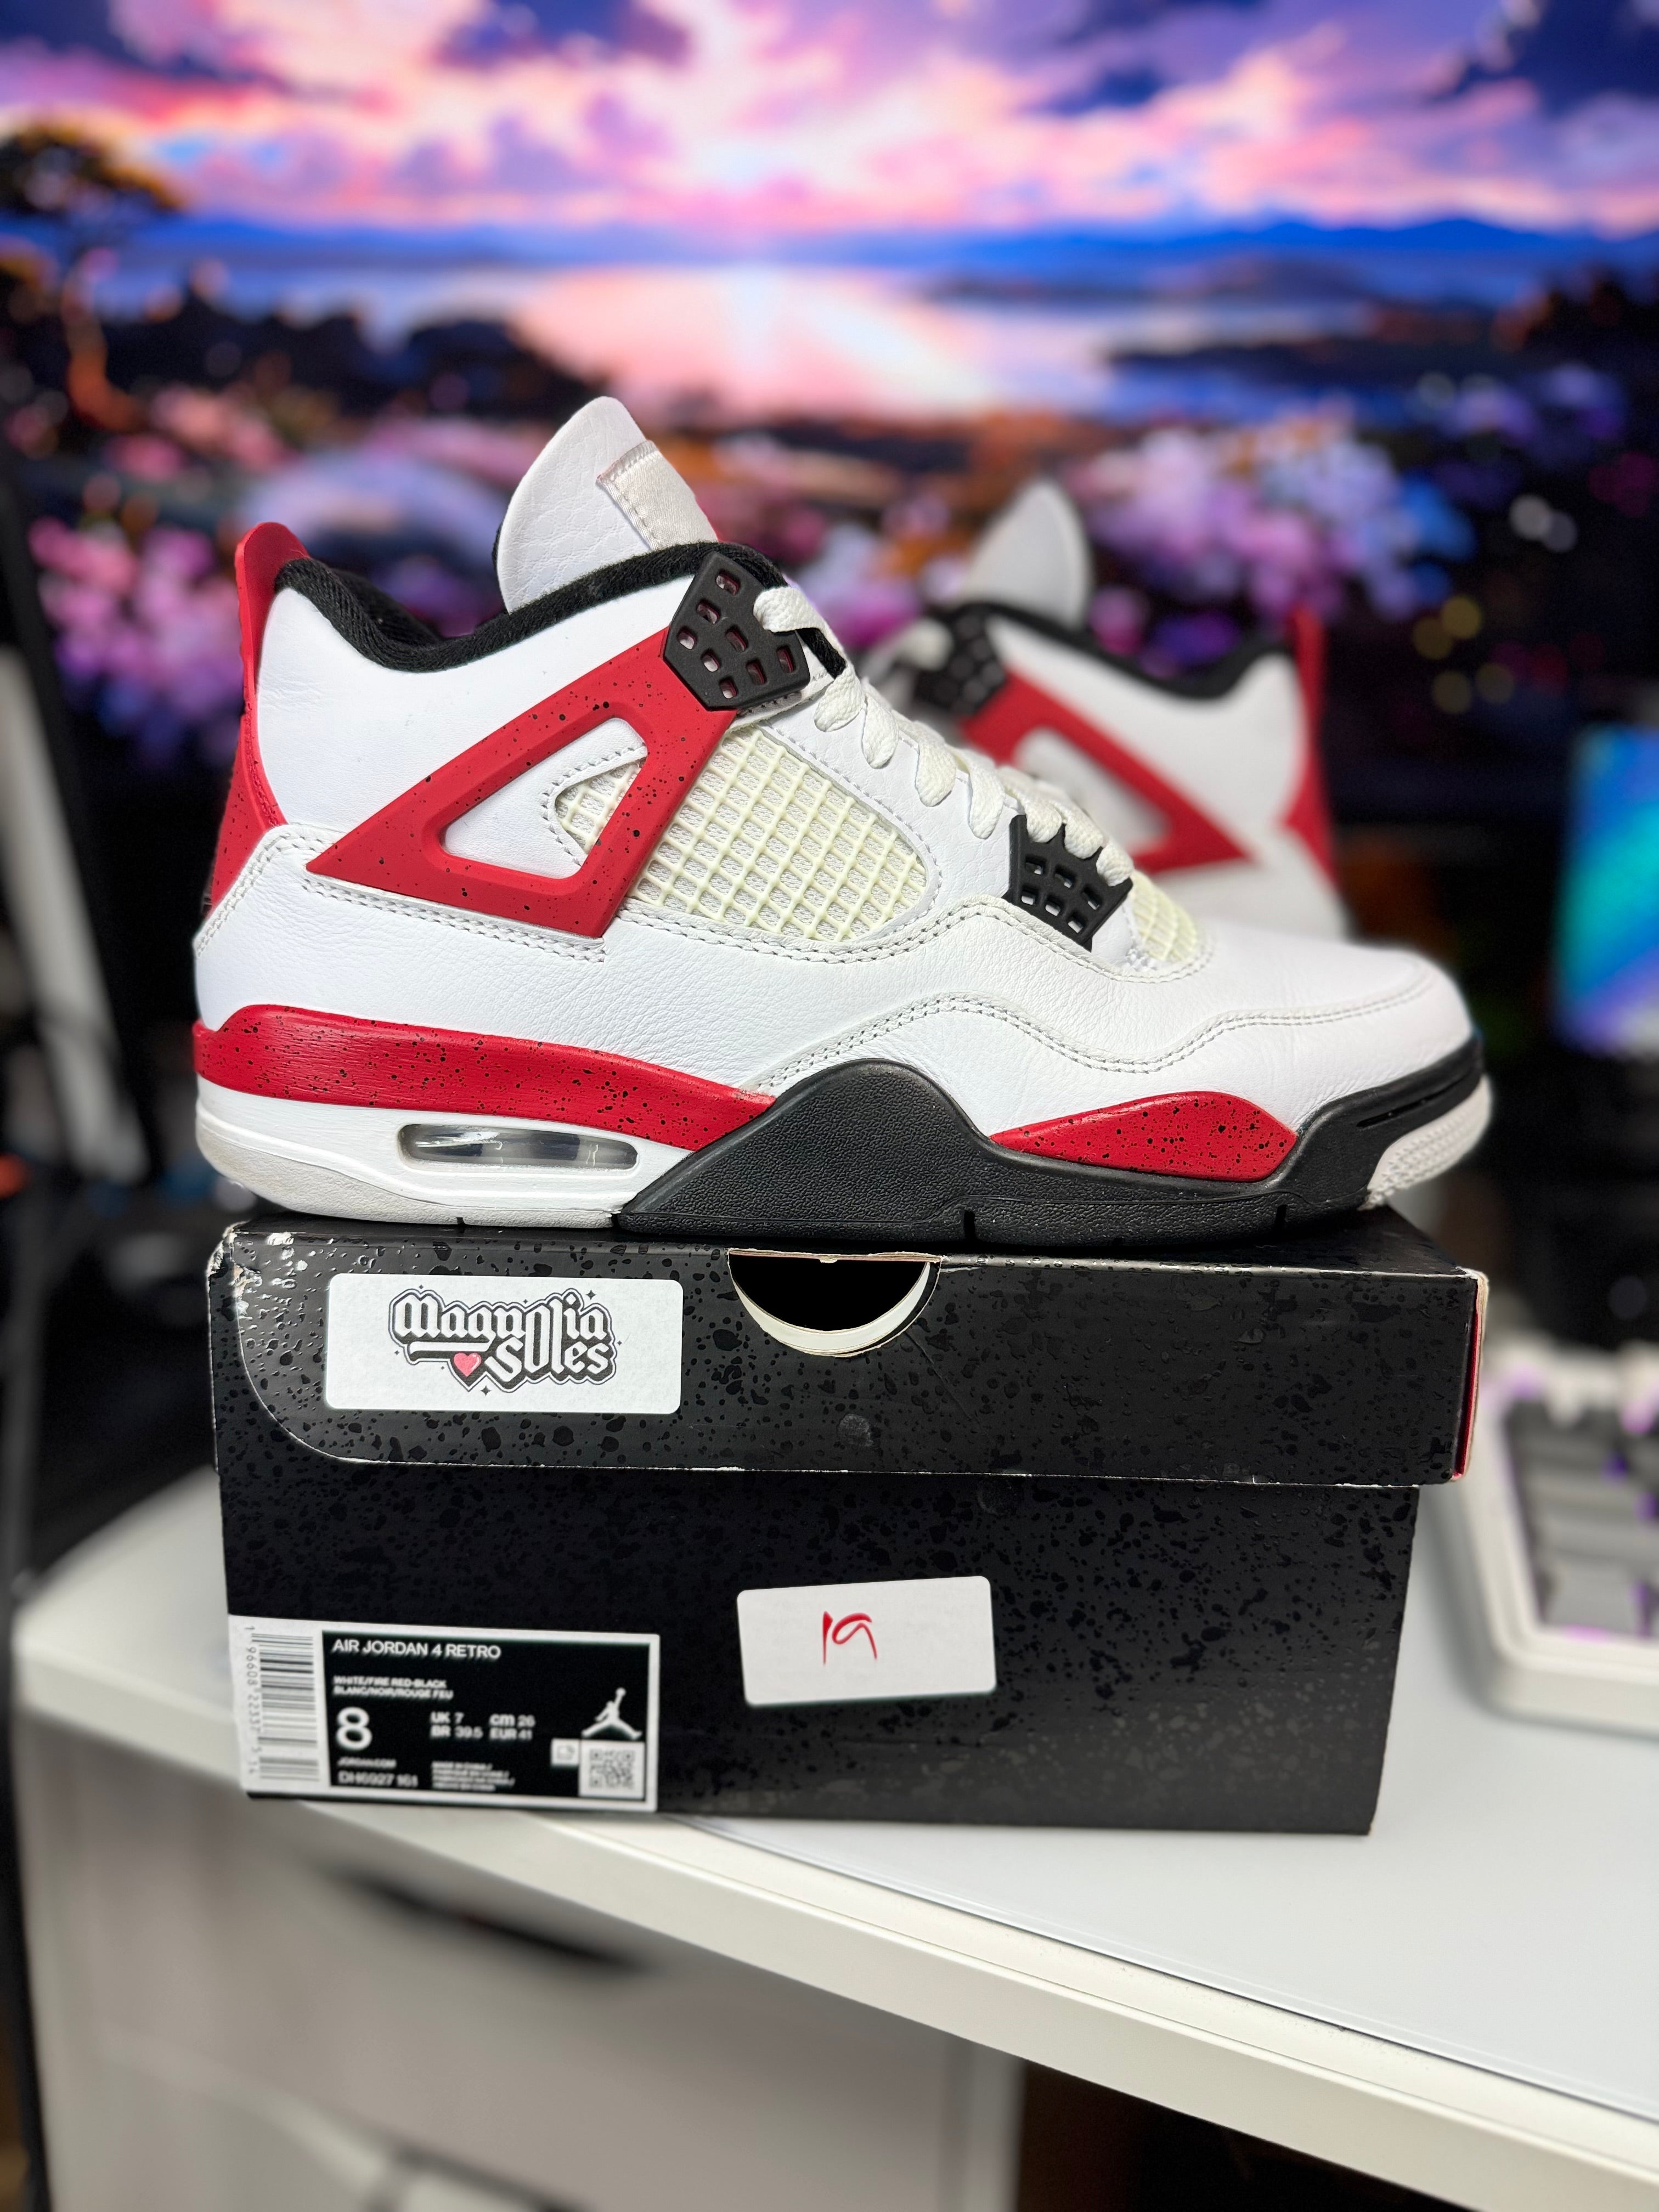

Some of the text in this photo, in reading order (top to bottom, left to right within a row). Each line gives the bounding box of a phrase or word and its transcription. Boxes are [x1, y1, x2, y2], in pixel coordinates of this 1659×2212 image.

[332, 1639, 501, 1659] AIR JORDAN 4 RETRO
[431, 1711, 464, 1724] UK 7
[489, 1713, 535, 1728] cm 26
[336, 1707, 373, 1751] 8
[431, 1725, 451, 1738] BR
[490, 1728, 517, 1740] EUR
